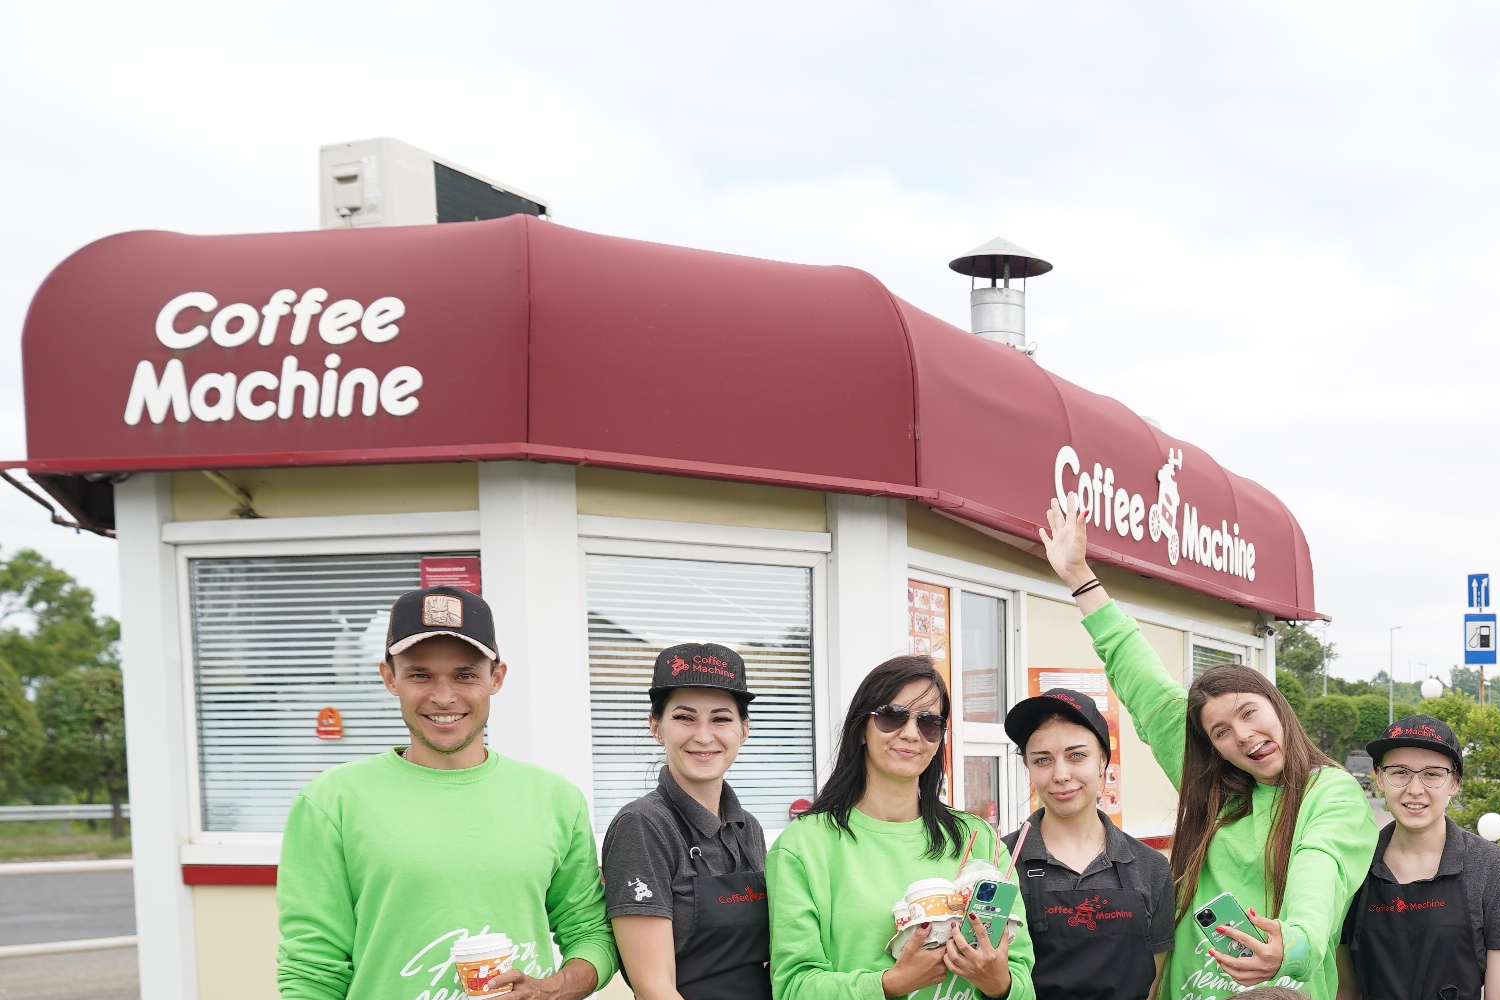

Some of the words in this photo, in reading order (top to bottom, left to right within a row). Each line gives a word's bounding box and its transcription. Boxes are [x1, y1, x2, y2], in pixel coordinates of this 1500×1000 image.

[154, 287, 406, 350] Coffee
[123, 353, 424, 426] Machine
[1054, 445, 1146, 542] Coffee
[1181, 502, 1256, 582] Machine
[692, 654, 728, 668] Coffee
[692, 664, 735, 679] Machine
[1405, 727, 1442, 741] Machine
[718, 893, 749, 904] Coffee
[1368, 904, 1395, 913] Coffee
[1409, 899, 1446, 911] Machine
[1095, 910, 1133, 920] Machine
